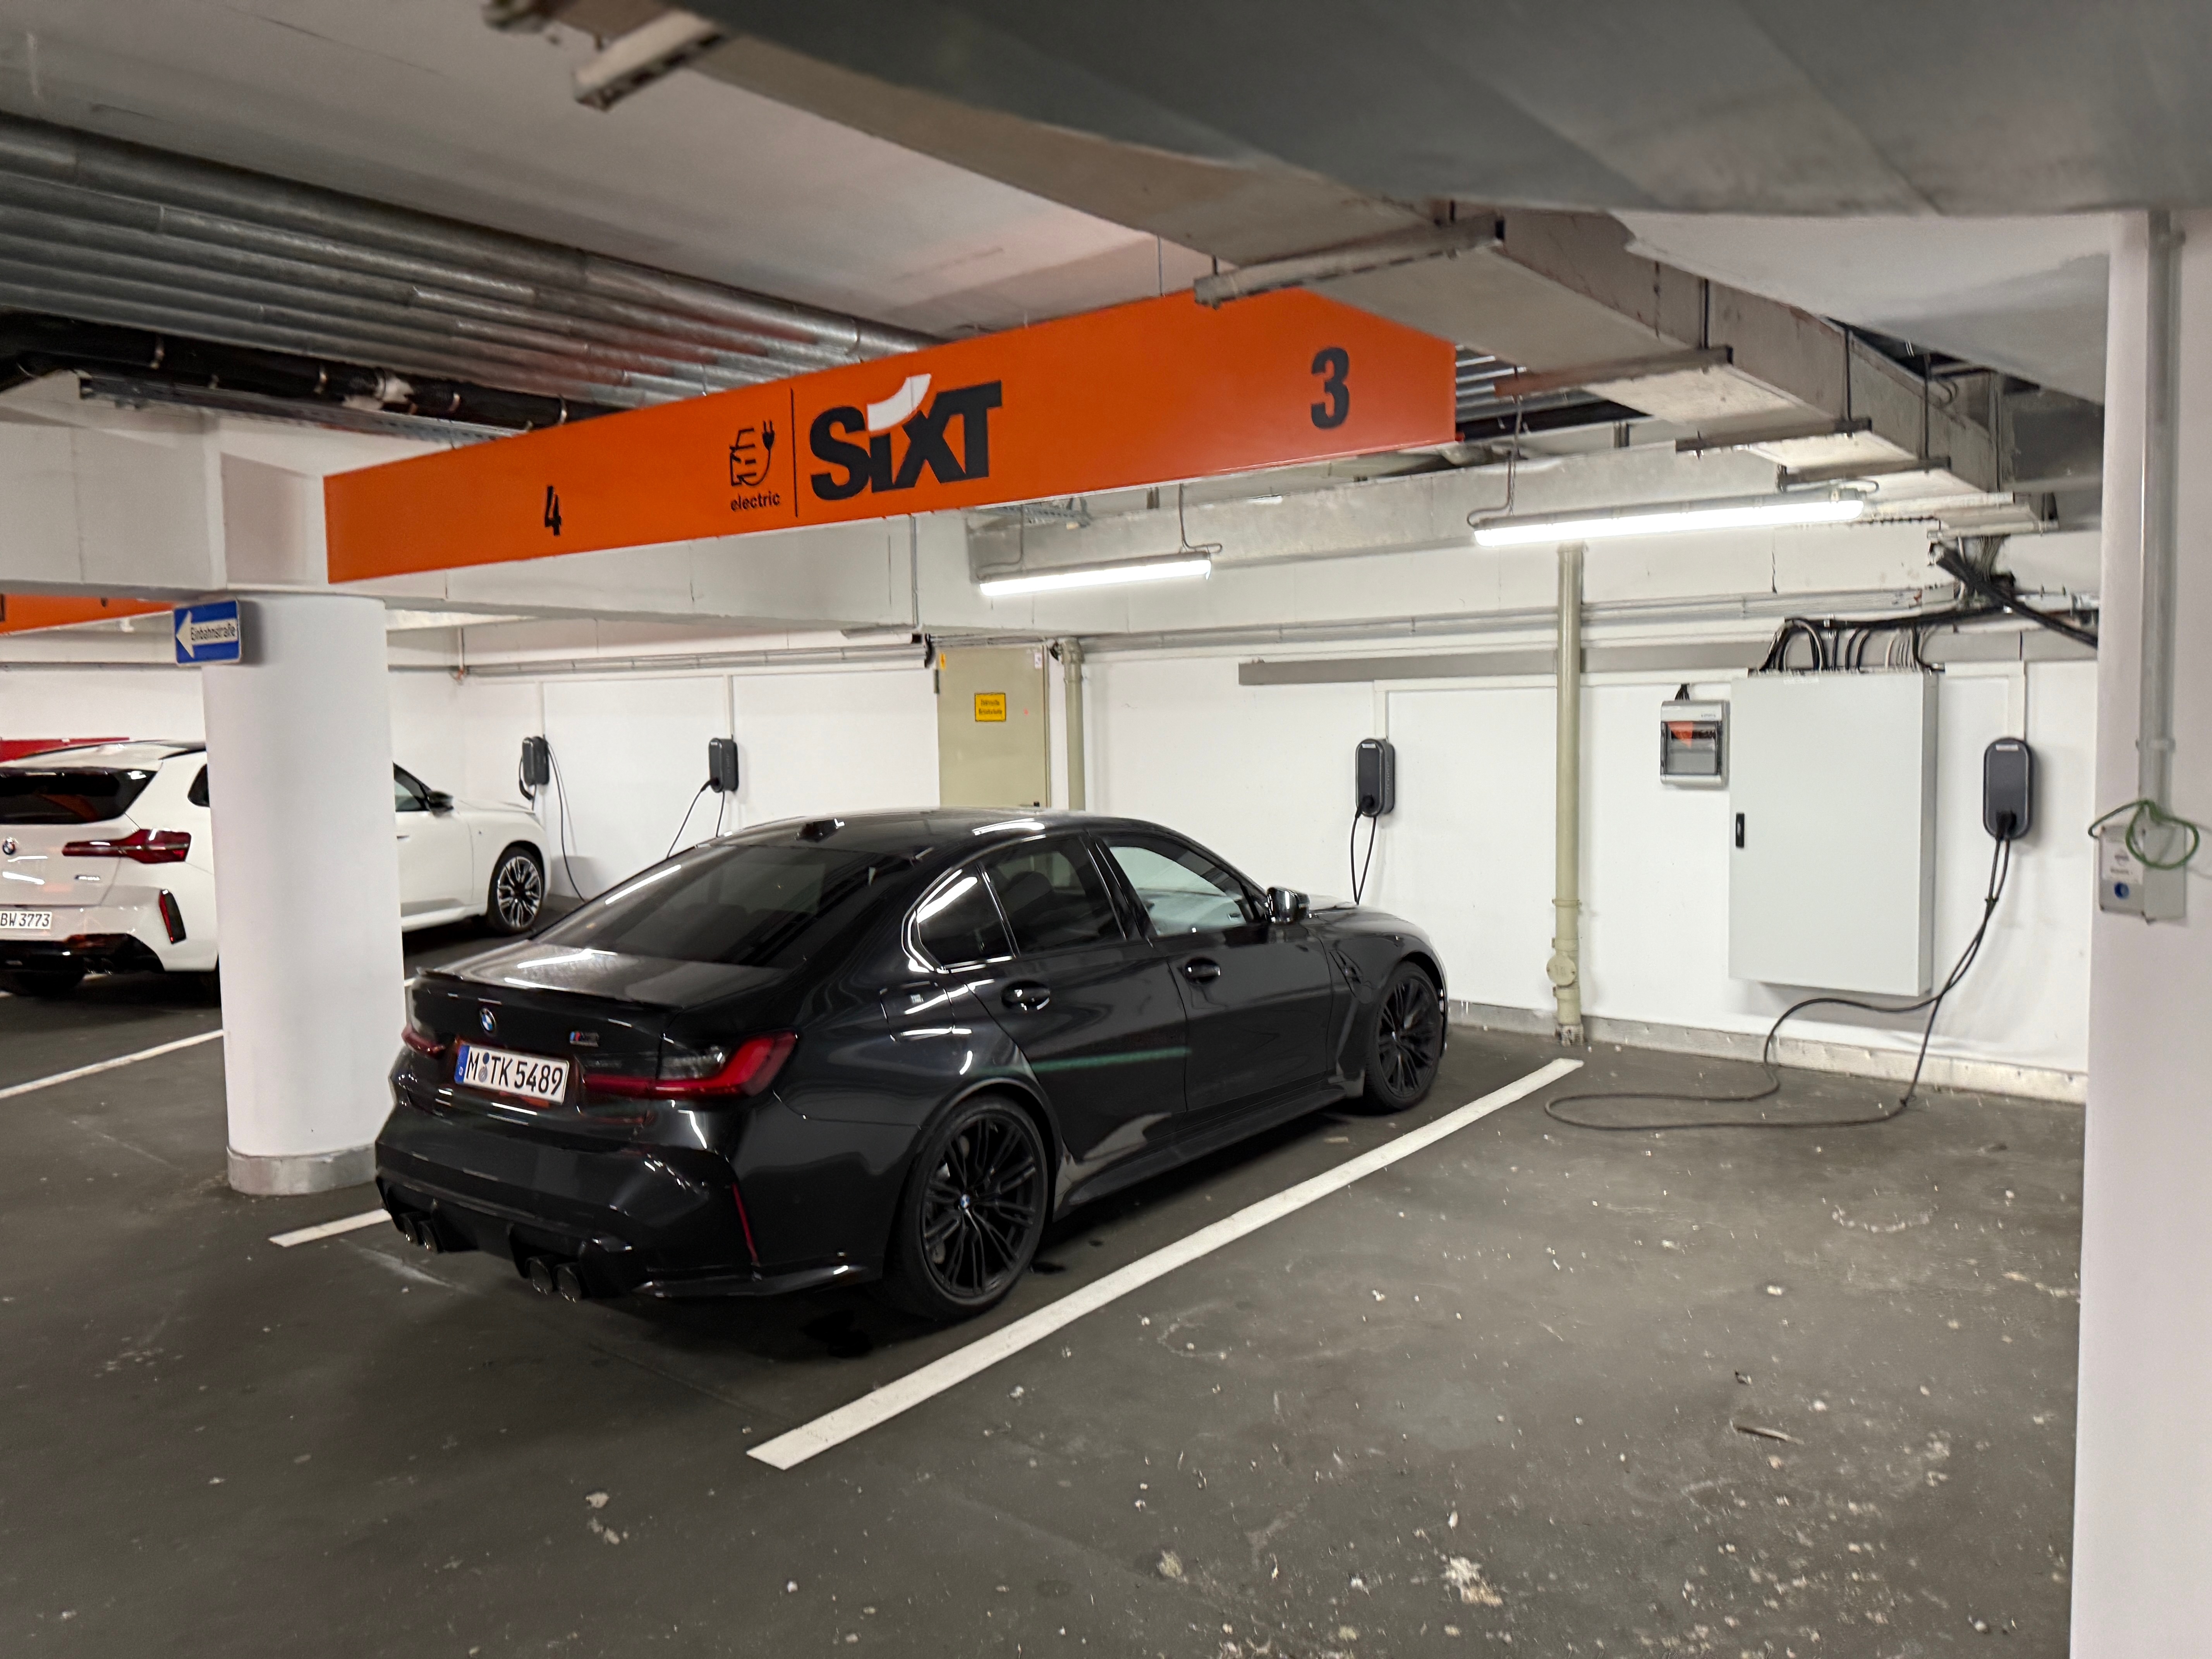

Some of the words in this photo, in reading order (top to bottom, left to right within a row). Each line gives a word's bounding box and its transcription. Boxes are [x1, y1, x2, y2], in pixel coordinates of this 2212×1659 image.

[1311, 347, 1349, 429] 3
[544, 485, 561, 536] 4
[731, 491, 780, 511] electric
[19, 913, 50, 927] 3773
[466, 1050, 480, 1080] M
[491, 1056, 513, 1087] TK
[514, 1060, 563, 1096] 5489
